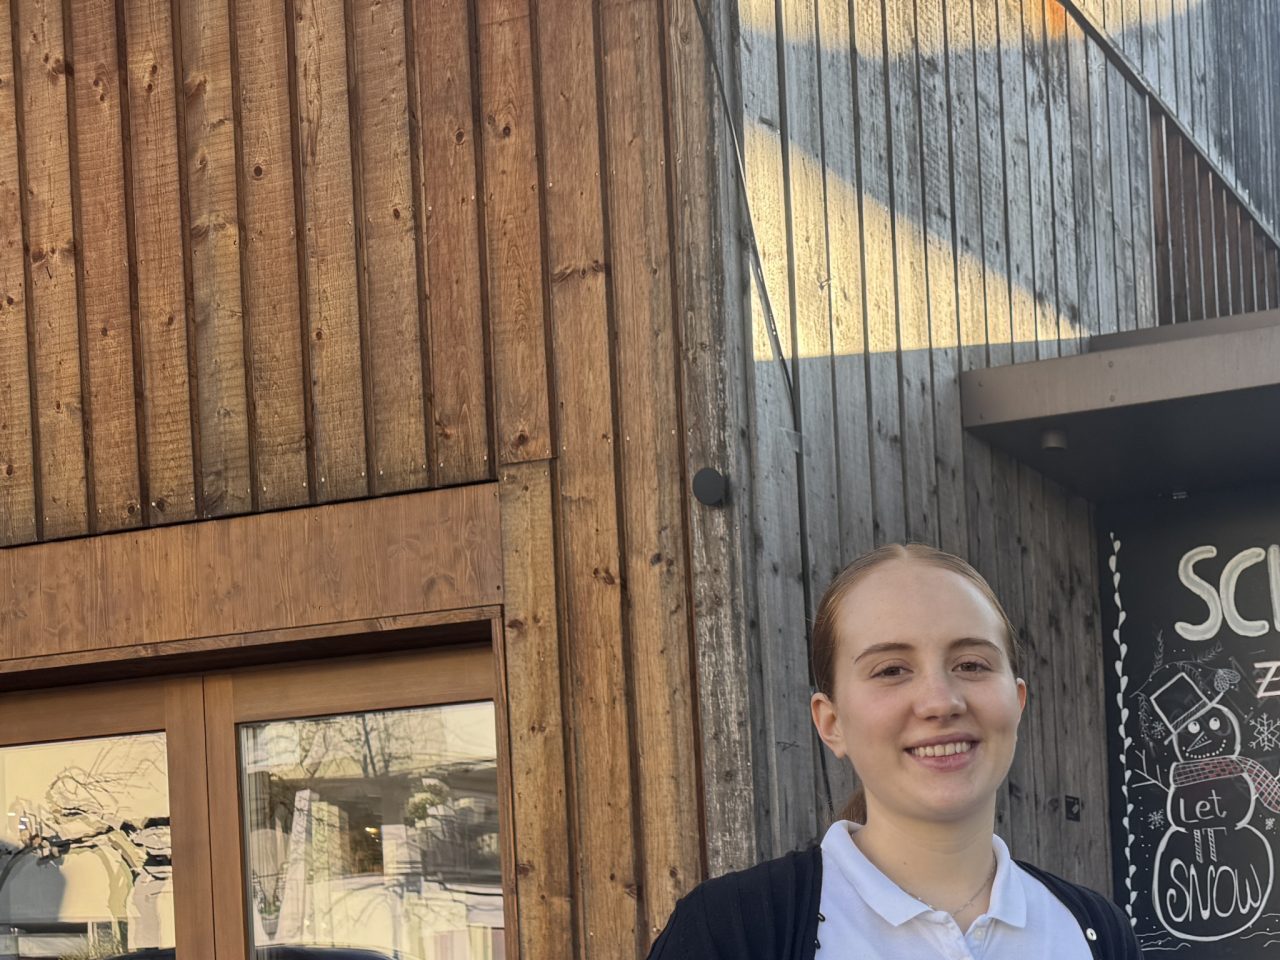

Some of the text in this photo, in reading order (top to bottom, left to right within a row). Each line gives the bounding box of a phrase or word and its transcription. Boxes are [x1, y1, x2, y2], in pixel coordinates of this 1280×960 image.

[1179, 789, 1227, 823] Let
[1193, 827, 1228, 864] IT
[1166, 858, 1262, 923] SNOW
